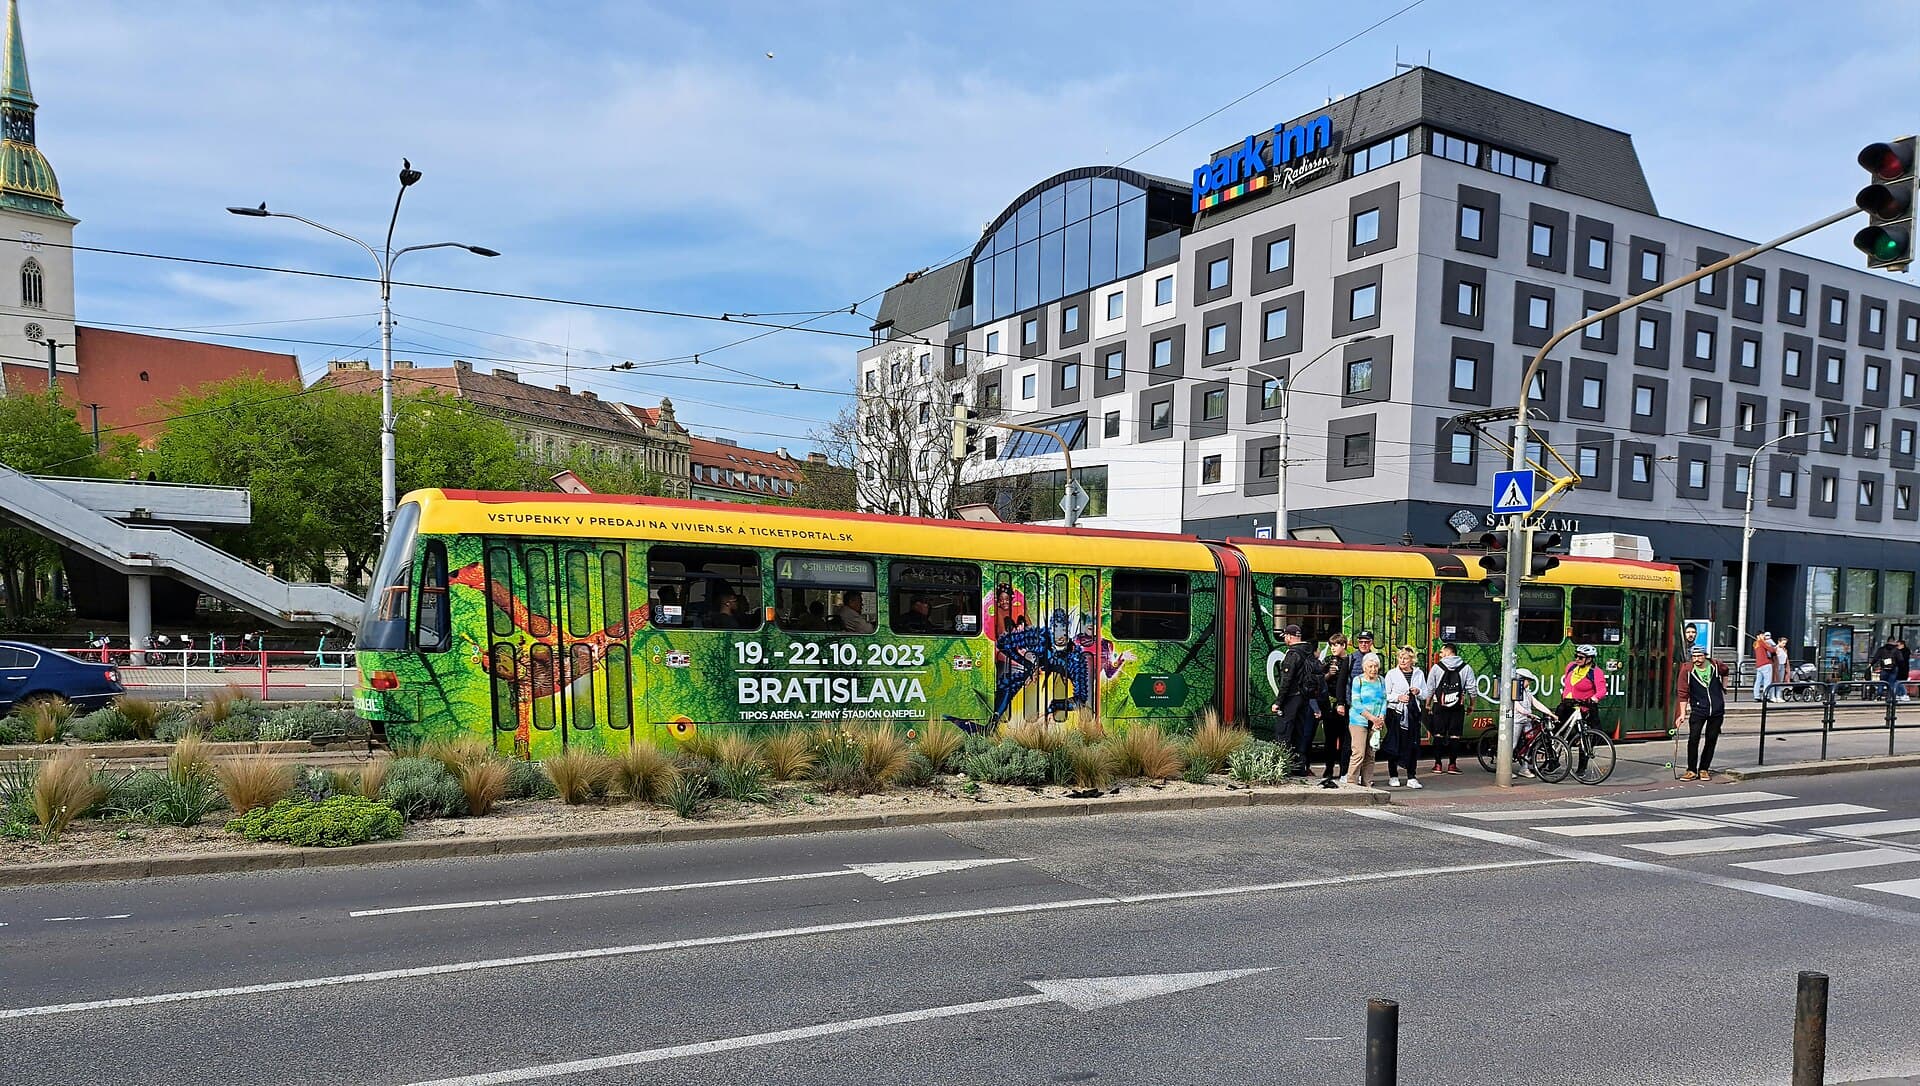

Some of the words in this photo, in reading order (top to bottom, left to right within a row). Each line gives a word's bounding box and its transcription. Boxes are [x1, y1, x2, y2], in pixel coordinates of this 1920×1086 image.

[1192, 135, 1267, 213] park
[1273, 115, 1332, 166] inn
[1273, 170, 1281, 183] by
[1283, 157, 1331, 189] Radisson
[488, 513, 570, 525] VSTUPENKY
[575, 517, 584, 525] V
[590, 517, 646, 528] PREDAJI
[649, 521, 667, 530] NA
[671, 522, 734, 534] VIVIEN.SK
[737, 527, 746, 535] A
[750, 527, 854, 543] TICKETPORTAL.SK
[1486, 513, 1580, 532] SAURAMI
[780, 559, 793, 579] 4
[735, 641, 769, 664] 19.
[867, 644, 925, 666] 2023
[738, 677, 927, 704] BRATISLAVA
[739, 711, 768, 720] TIPOS
[770, 708, 803, 719] ARÉNA
[811, 708, 840, 719] ZIMNÝ
[842, 708, 881, 718] ŠTADIÓN
